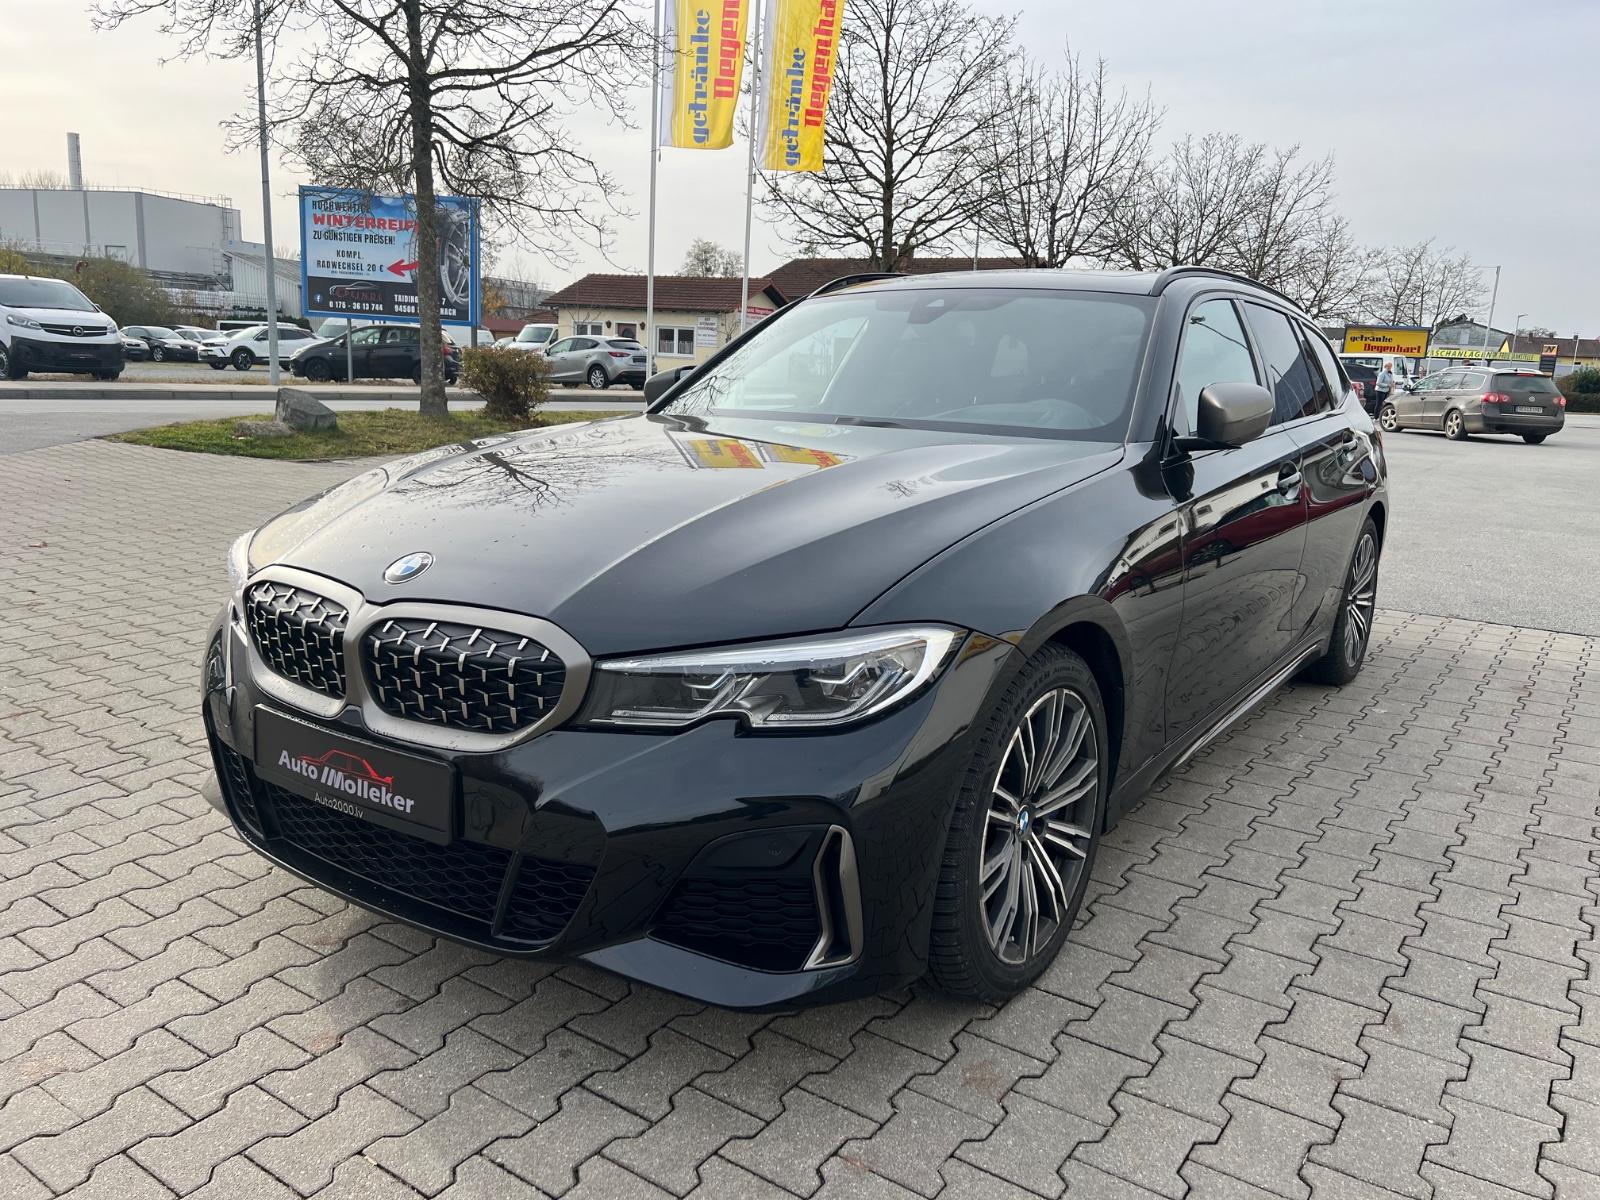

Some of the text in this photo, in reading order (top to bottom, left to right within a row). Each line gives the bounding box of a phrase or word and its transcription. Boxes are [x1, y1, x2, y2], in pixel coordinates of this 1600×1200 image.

[688, 9, 711, 144] getränke
[782, 47, 806, 167] getränke
[313, 230, 322, 240] ZU
[324, 230, 362, 244] GÜNSTIGEN
[336, 249, 364, 260] KOMPL.
[316, 260, 364, 272] RADWECHSEL
[367, 264, 377, 273] 20
[379, 265, 384, 273] €
[329, 300, 334, 309] 0
[362, 303, 370, 312] 13
[278, 750, 318, 780] Auto
[314, 792, 364, 818] Auto2000.lv
